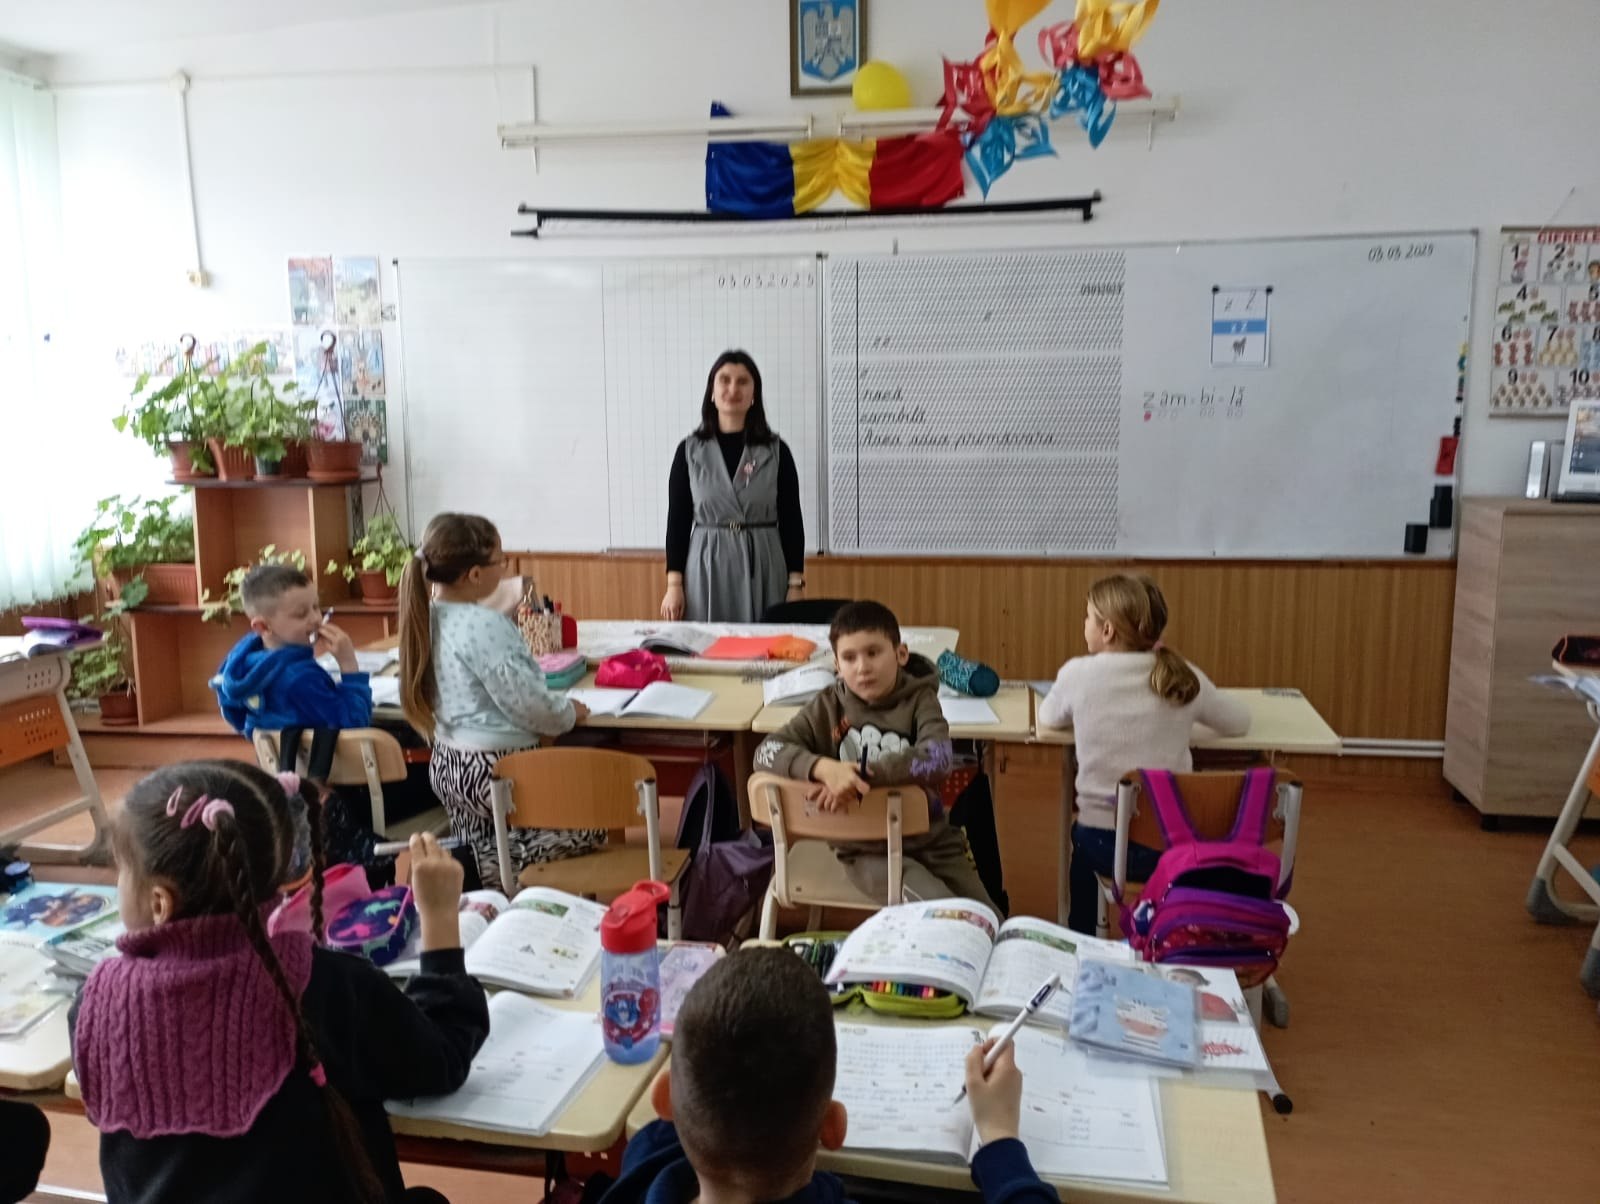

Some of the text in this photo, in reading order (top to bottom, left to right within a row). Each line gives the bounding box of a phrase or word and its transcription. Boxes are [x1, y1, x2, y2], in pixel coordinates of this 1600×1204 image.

[1511, 243, 1566, 261] 1 2
[1516, 284, 1528, 301] 4
[1501, 326, 1513, 343] 6
[1548, 325, 1558, 341] 7
[1507, 368, 1590, 386] 9 10
